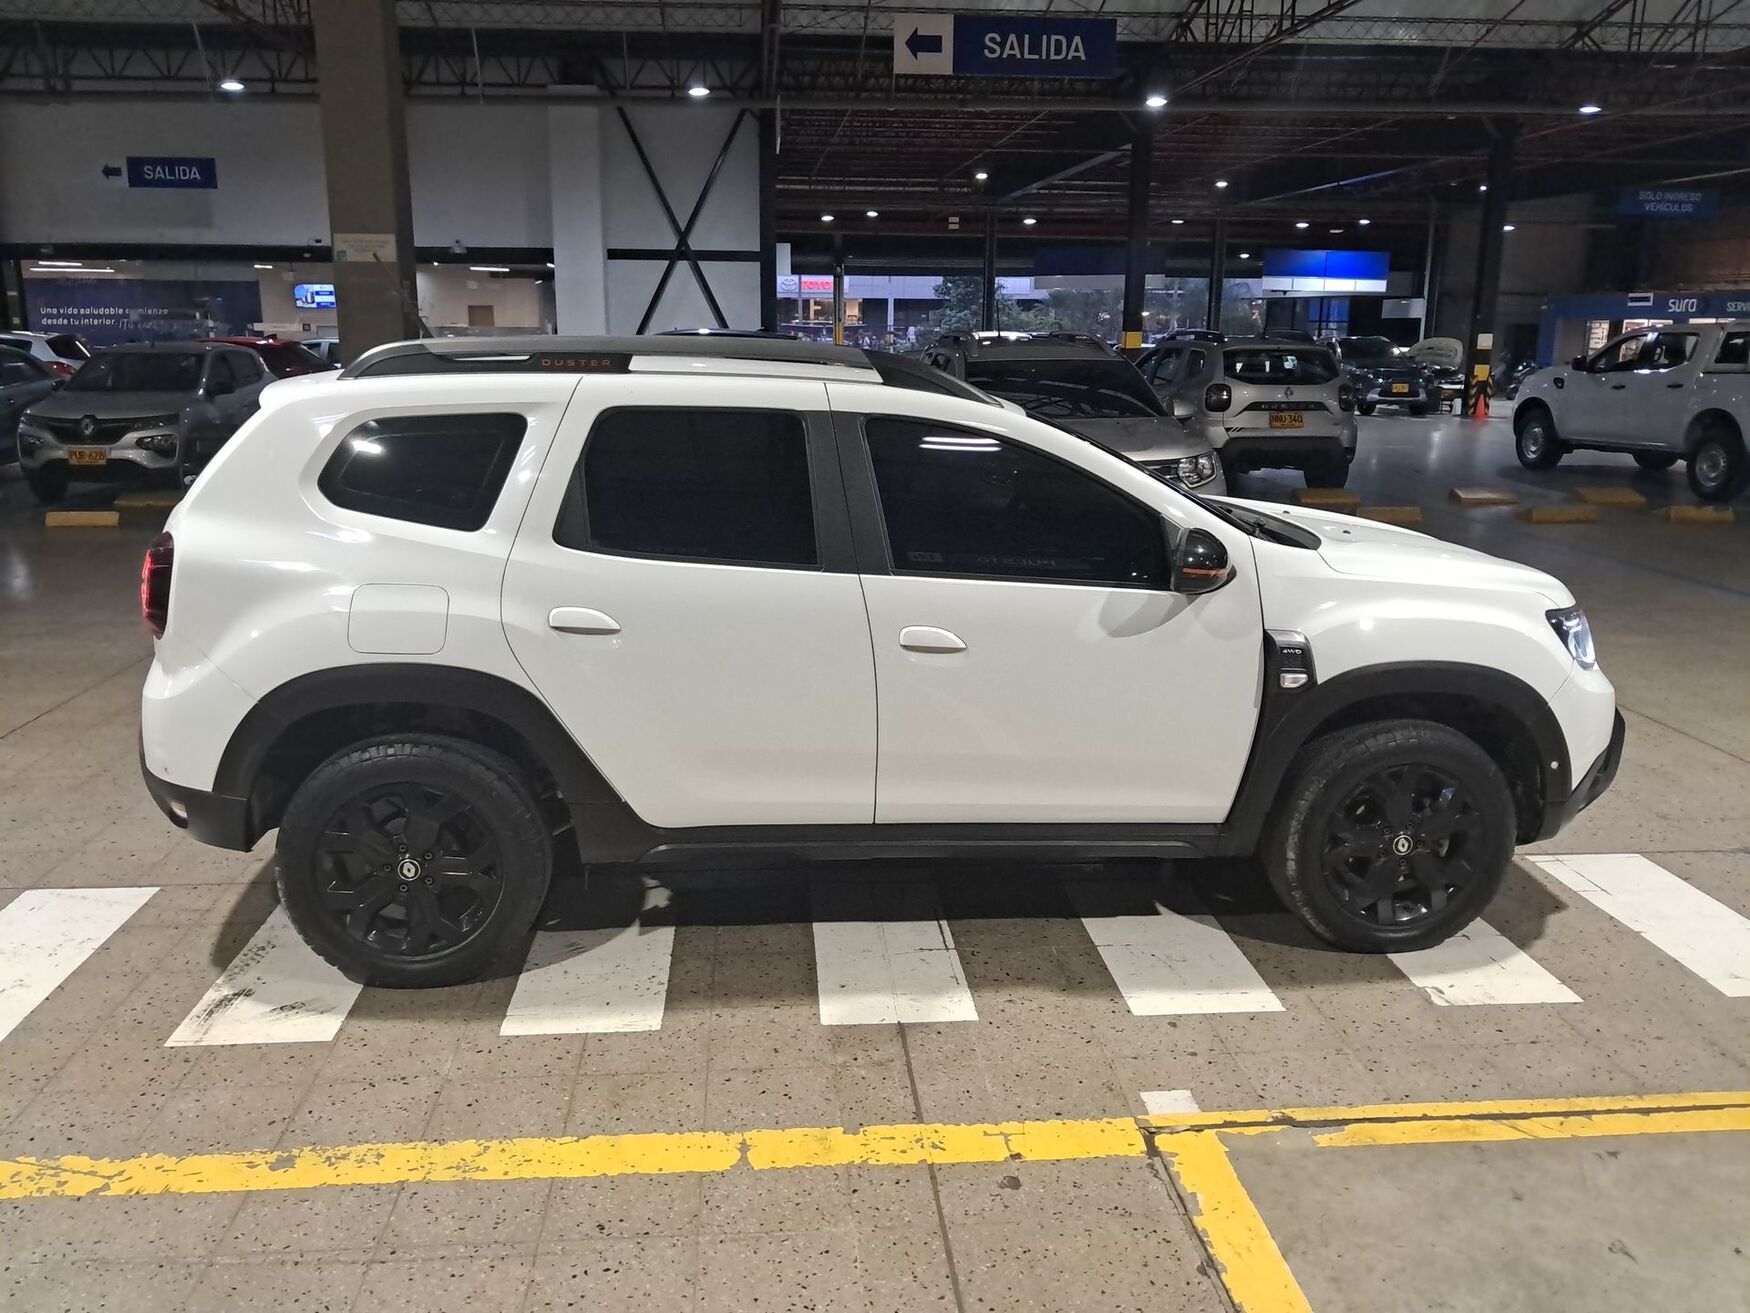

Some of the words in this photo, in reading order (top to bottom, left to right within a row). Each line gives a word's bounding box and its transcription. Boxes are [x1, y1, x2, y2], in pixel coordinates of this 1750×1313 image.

[983, 32, 1087, 61] SALIDA
[143, 165, 202, 180] SALIDA
[40, 306, 58, 315] Una
[59, 306, 78, 315] vida
[79, 306, 123, 315] saludable
[1667, 298, 1698, 313] sura
[41, 317, 68, 326] desde
[70, 317, 79, 326] tu
[541, 358, 611, 367] DUSTER
